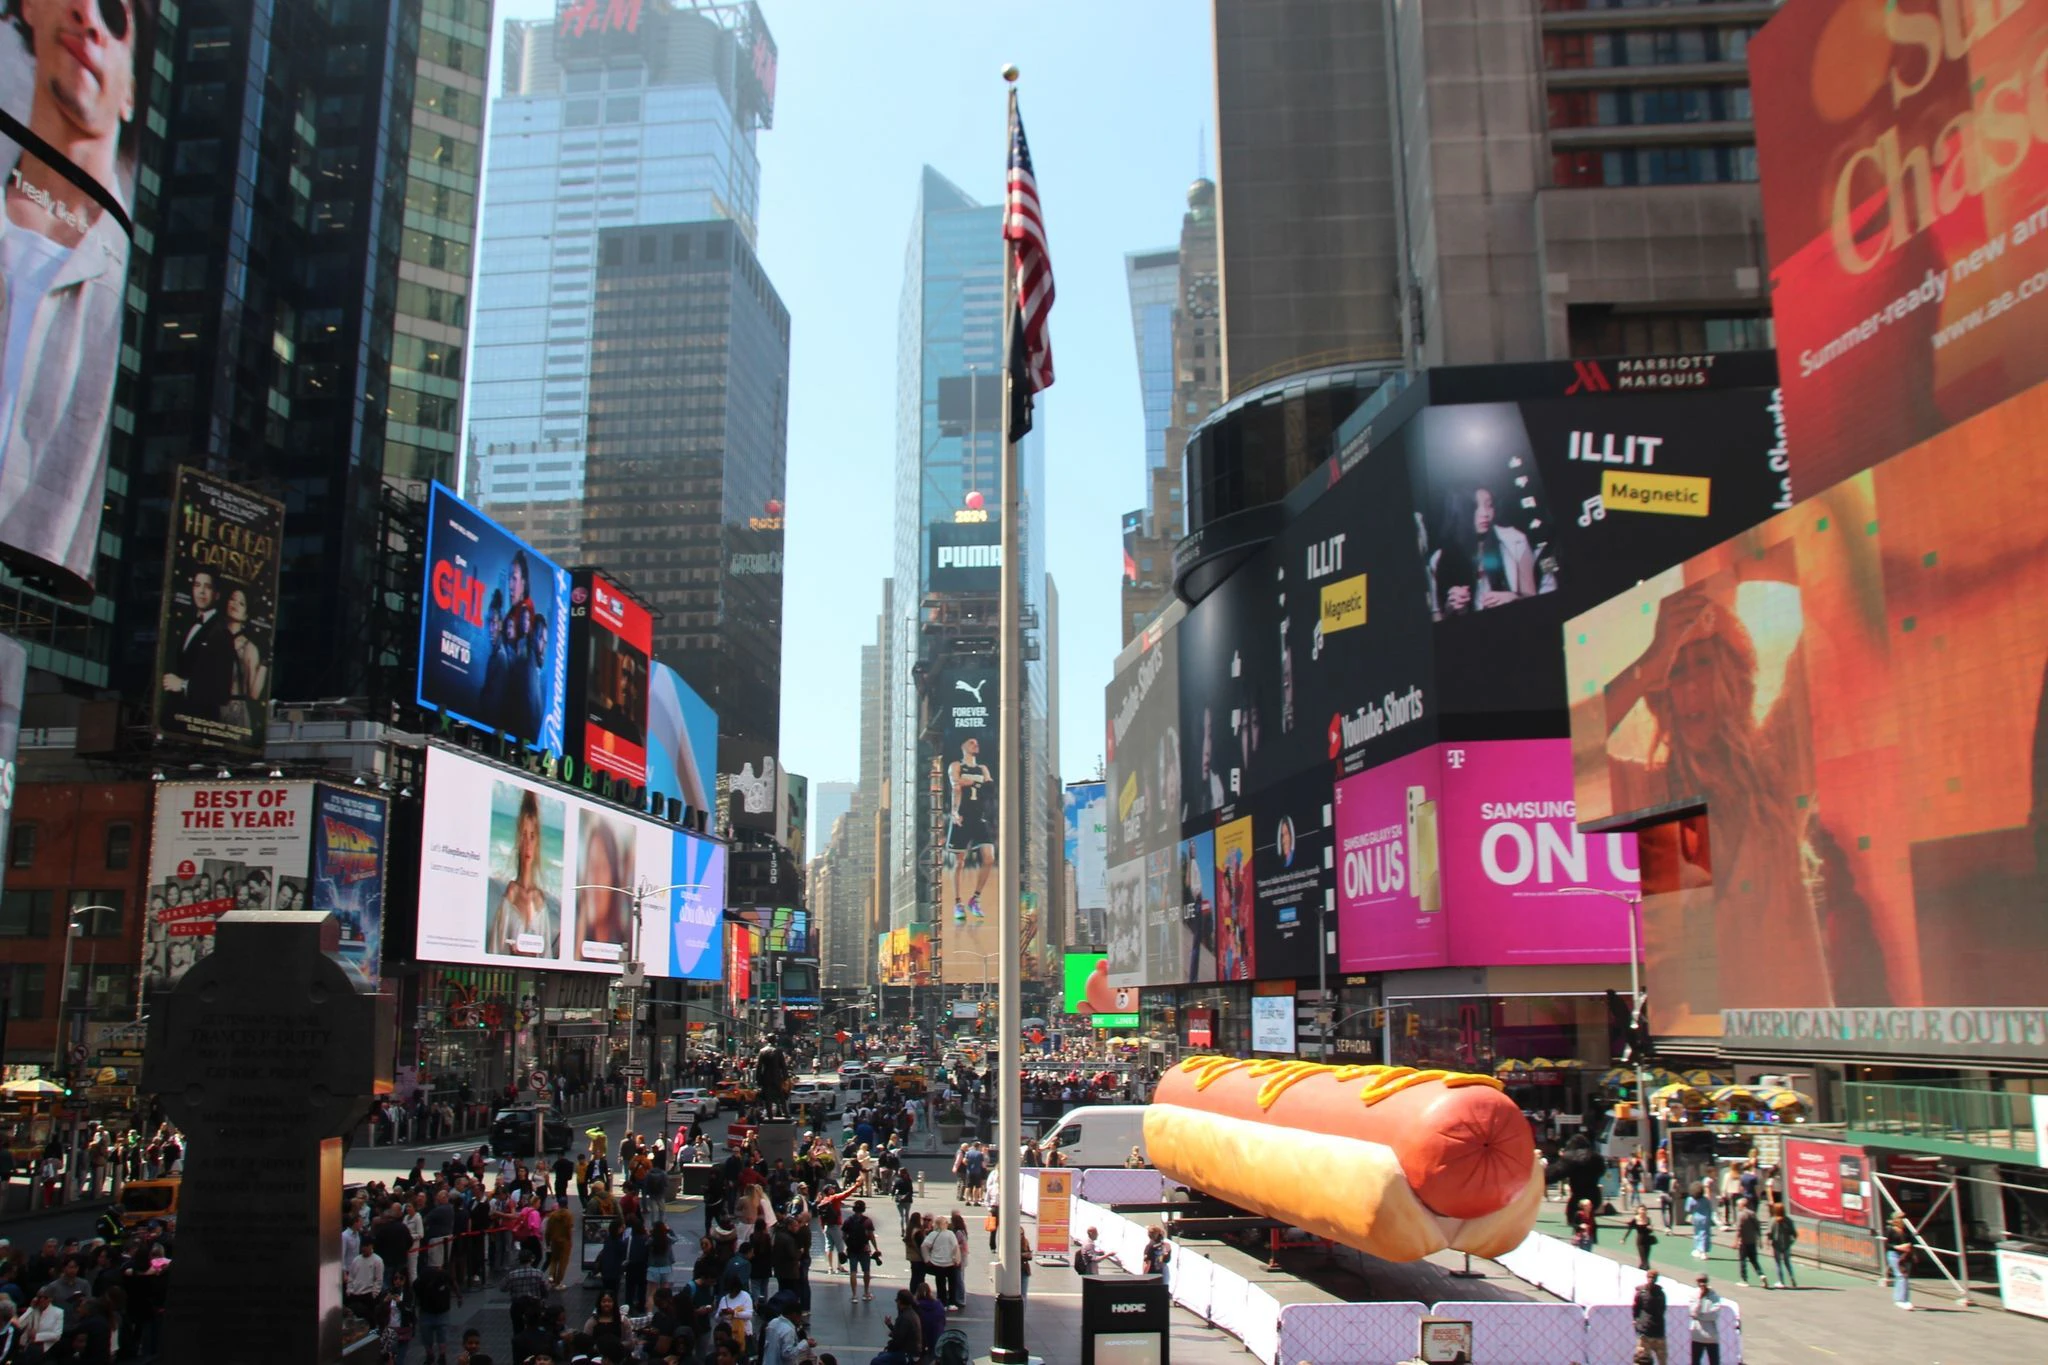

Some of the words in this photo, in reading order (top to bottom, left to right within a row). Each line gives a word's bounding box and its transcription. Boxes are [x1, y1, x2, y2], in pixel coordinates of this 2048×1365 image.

[1799, 265, 1948, 377] Summer-ready
[1953, 232, 2006, 282] new
[1619, 355, 1716, 372] MARRIOTT
[1619, 371, 1706, 388] MARQUIS
[1568, 430, 1663, 466] ILLIT
[1610, 482, 1699, 505] Magnetic
[937, 544, 1003, 568] PUMA
[1307, 532, 1346, 581] ILLIT
[571, 606, 586, 617] LG
[1324, 591, 1362, 622] Magnetic
[952, 706, 989, 717] FOREVER.
[1341, 702, 1384, 749] YouTube
[1384, 684, 1424, 731] Shorts
[955, 717, 987, 728] FASTER.
[193, 790, 253, 809] BEST
[257, 789, 288, 808] OF
[181, 810, 225, 829] THE
[230, 809, 295, 829] YEAR!
[1480, 800, 1577, 821] SAMSUNG
[1480, 821, 1589, 887] ON
[1343, 848, 1373, 899] ON
[1375, 839, 1405, 894] US
[1183, 902, 1197, 919] LIFE
[1724, 1009, 1846, 1040] AMERICAN
[1852, 1010, 1944, 1042] EAGLE
[1336, 1038, 1372, 1055] SEPHORA
[1111, 1303, 1147, 1314] HOPE
